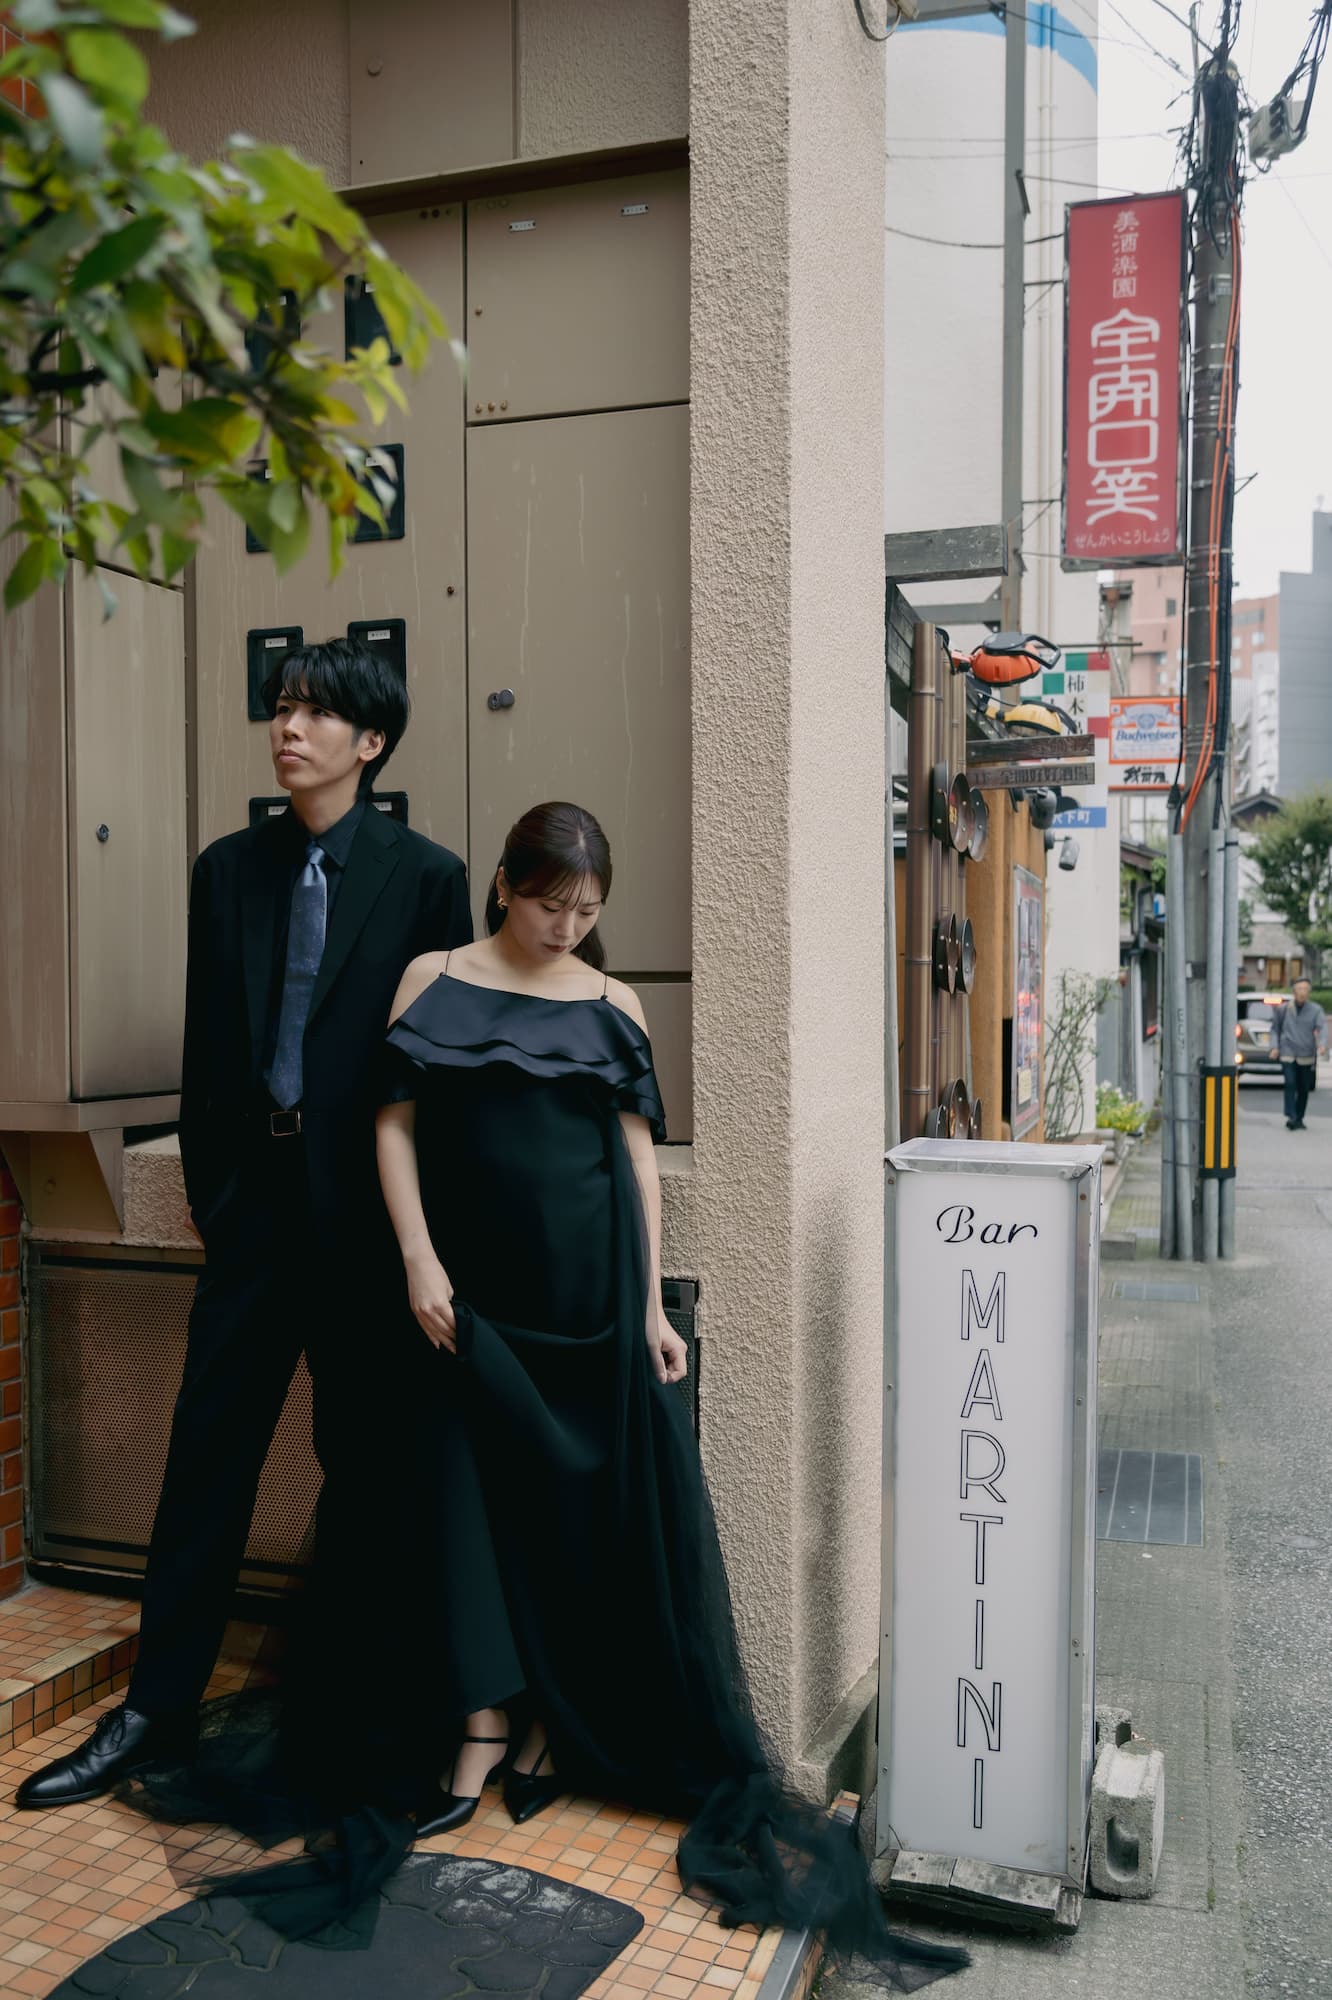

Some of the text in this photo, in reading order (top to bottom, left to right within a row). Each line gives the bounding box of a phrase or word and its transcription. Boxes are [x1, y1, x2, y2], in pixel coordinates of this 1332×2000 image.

[1116, 730, 1177, 741] Budweiser
[936, 1205, 1038, 1244] Bar
[957, 1269, 1007, 1828] MARTINI
